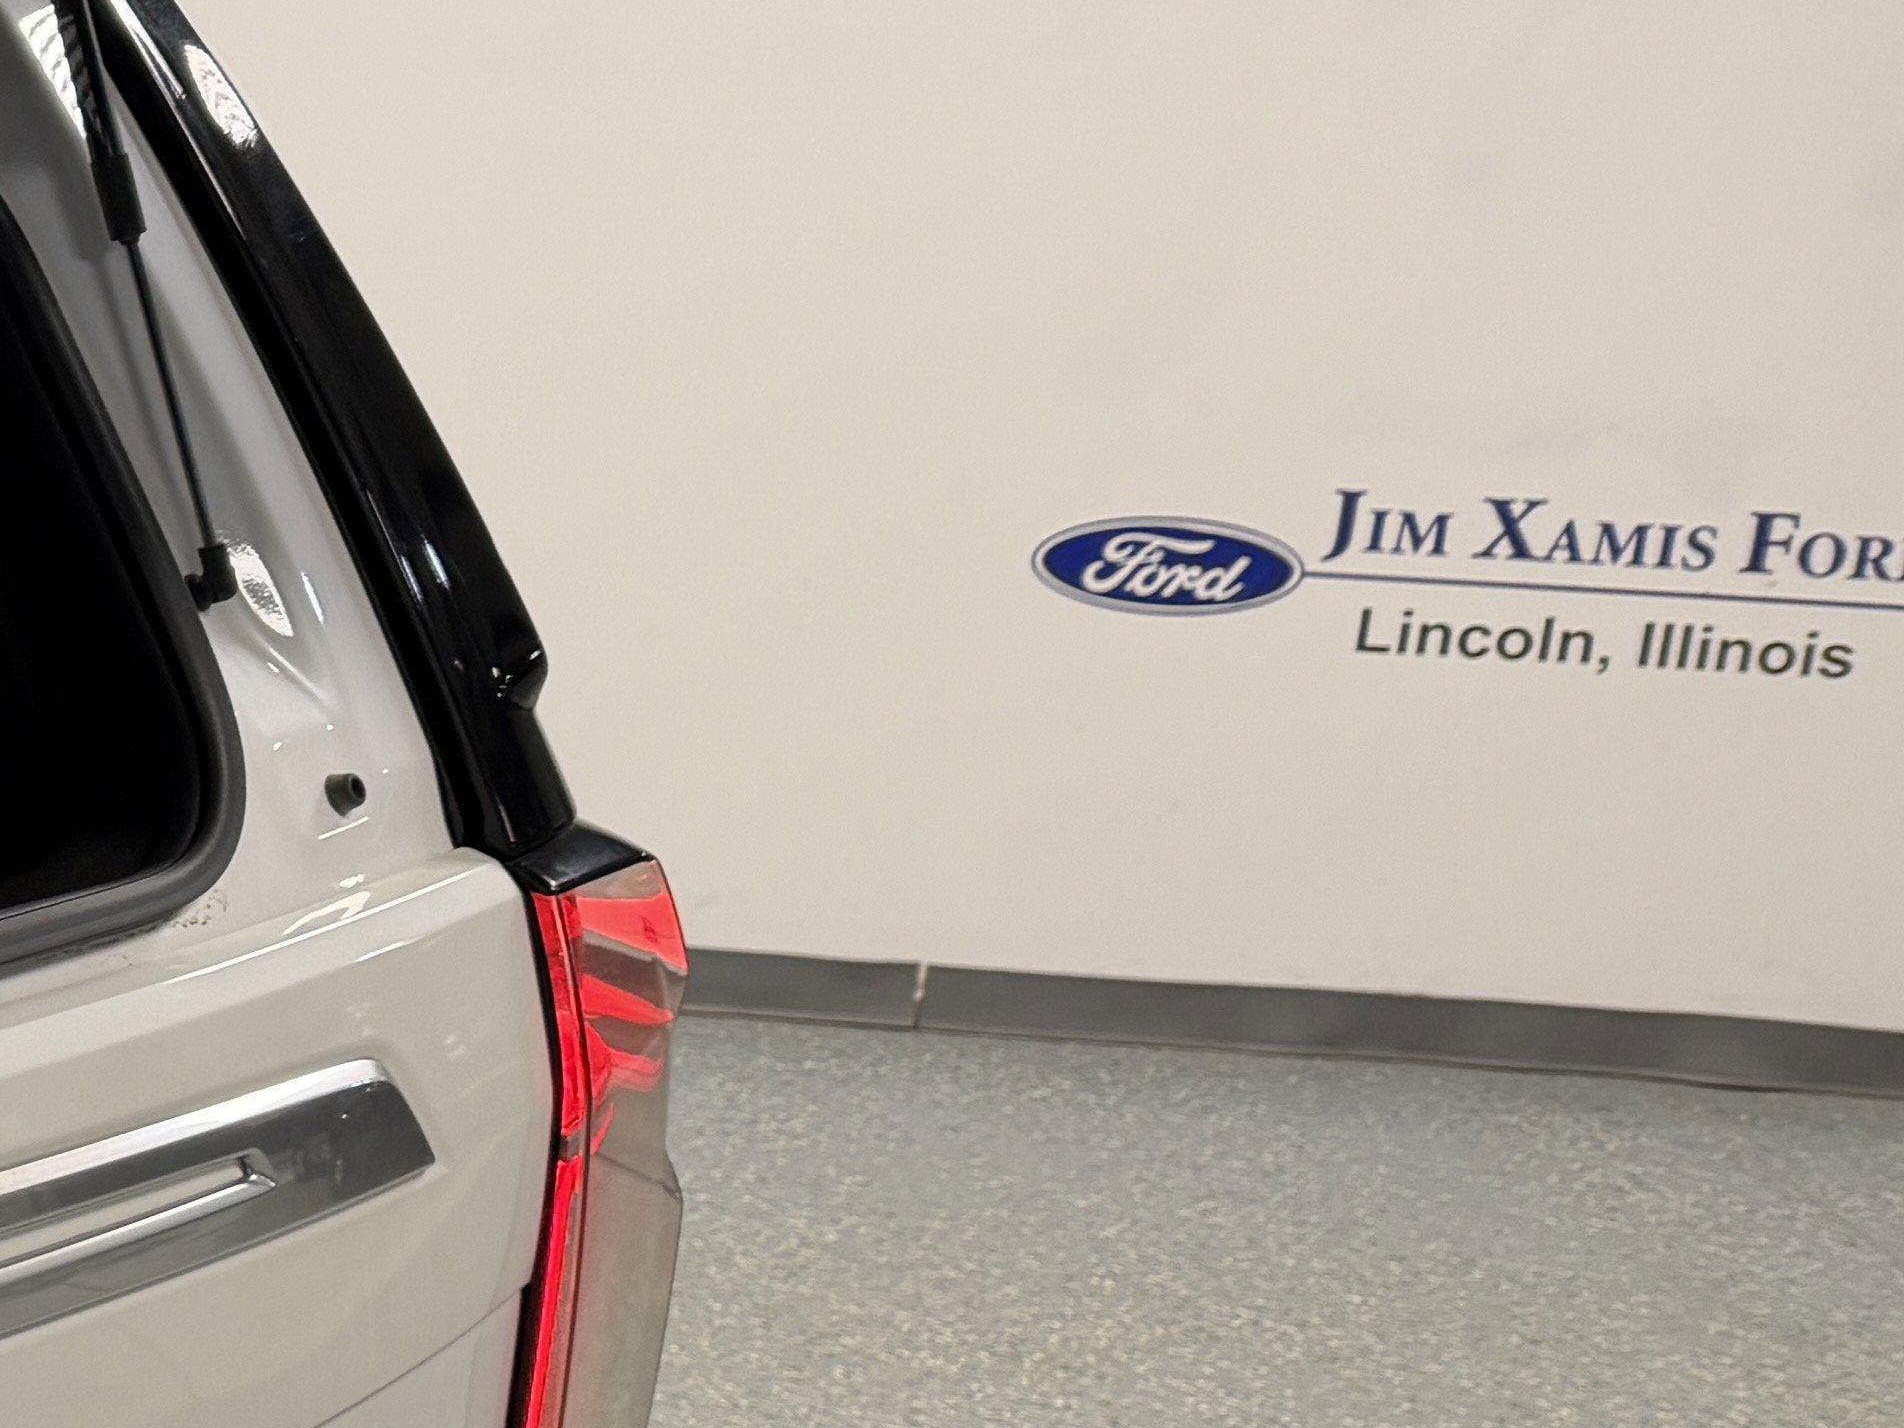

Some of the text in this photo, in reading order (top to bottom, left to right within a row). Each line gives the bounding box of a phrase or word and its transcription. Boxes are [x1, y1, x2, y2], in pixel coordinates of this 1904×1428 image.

[1081, 529, 1252, 602] Ford
[1320, 488, 1904, 582] JIM XAMIS FOR
[1355, 606, 1855, 679] Lincoln, Illinois
